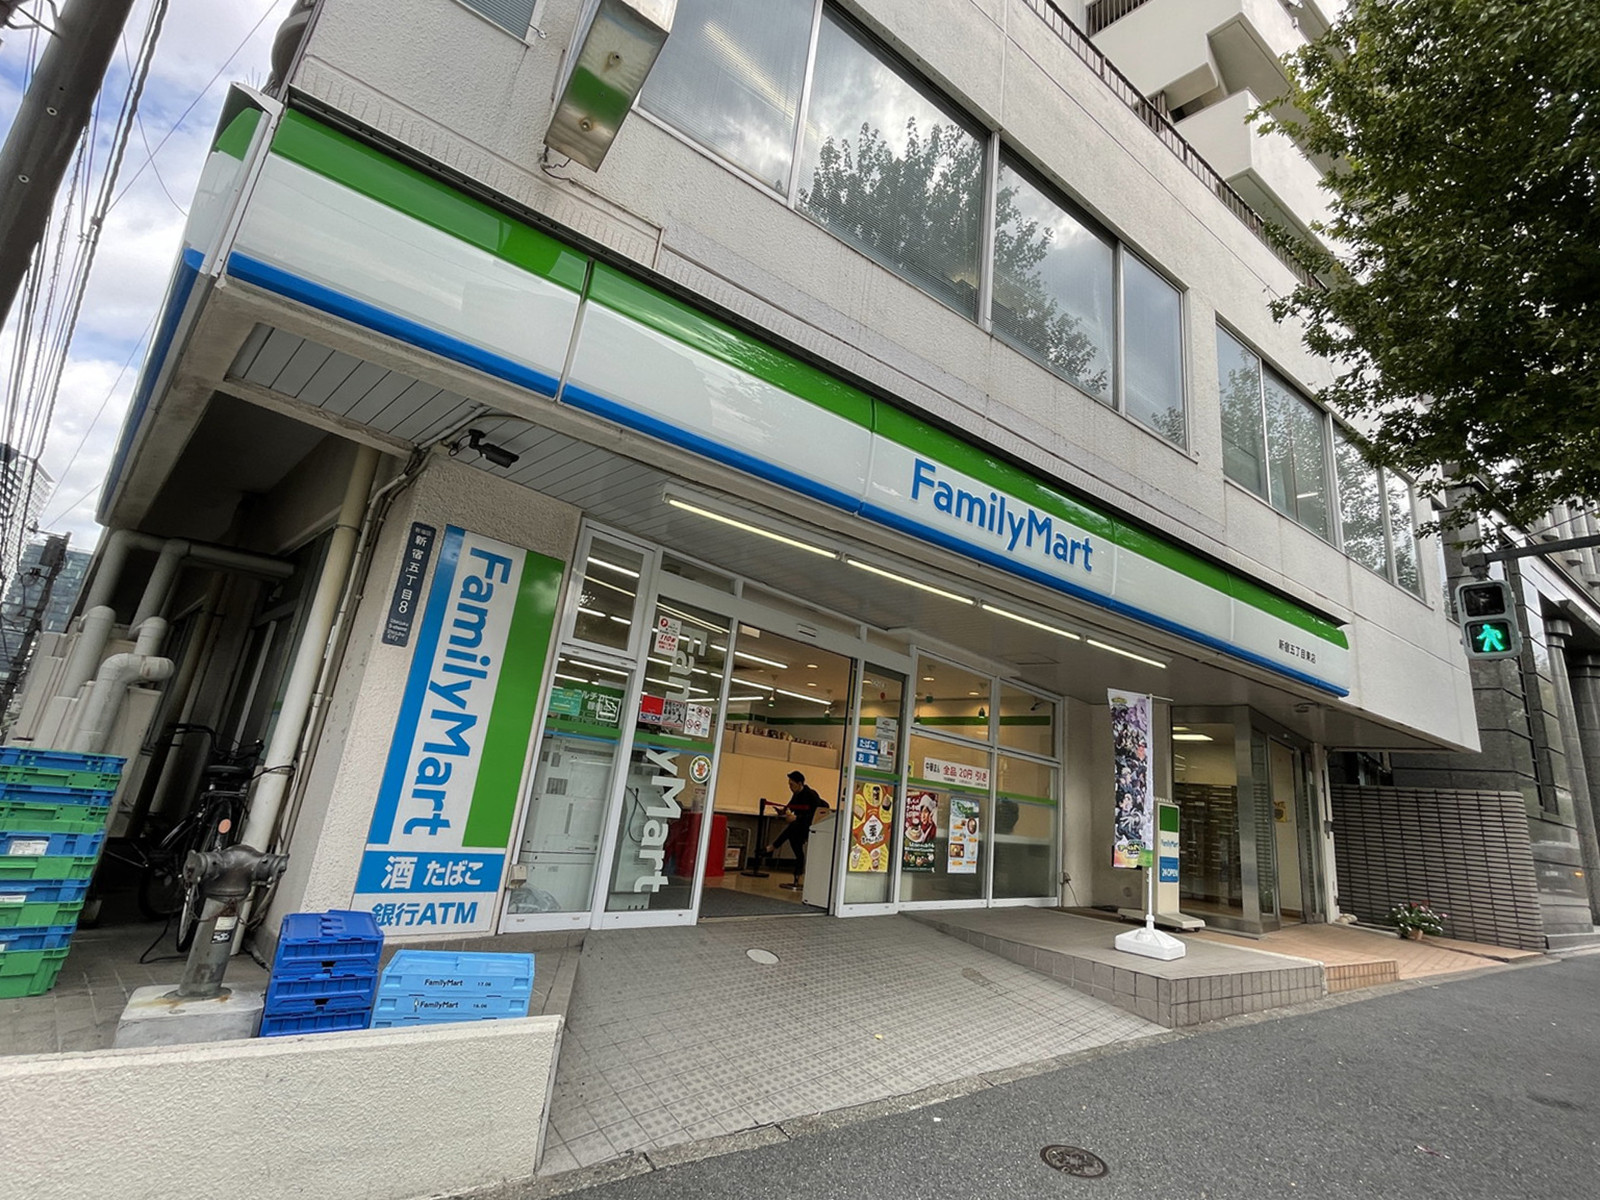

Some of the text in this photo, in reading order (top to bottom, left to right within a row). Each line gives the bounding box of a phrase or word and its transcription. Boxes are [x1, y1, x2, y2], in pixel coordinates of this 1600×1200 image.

[911, 458, 1093, 572] FamilyMart
[402, 546, 514, 837] FamilyMart
[380, 856, 483, 890] 酒 たばこ
[371, 902, 479, 929] 銀行ATM
[424, 978, 464, 988] FamilyMart
[419, 1000, 459, 1010] FamilyMart
